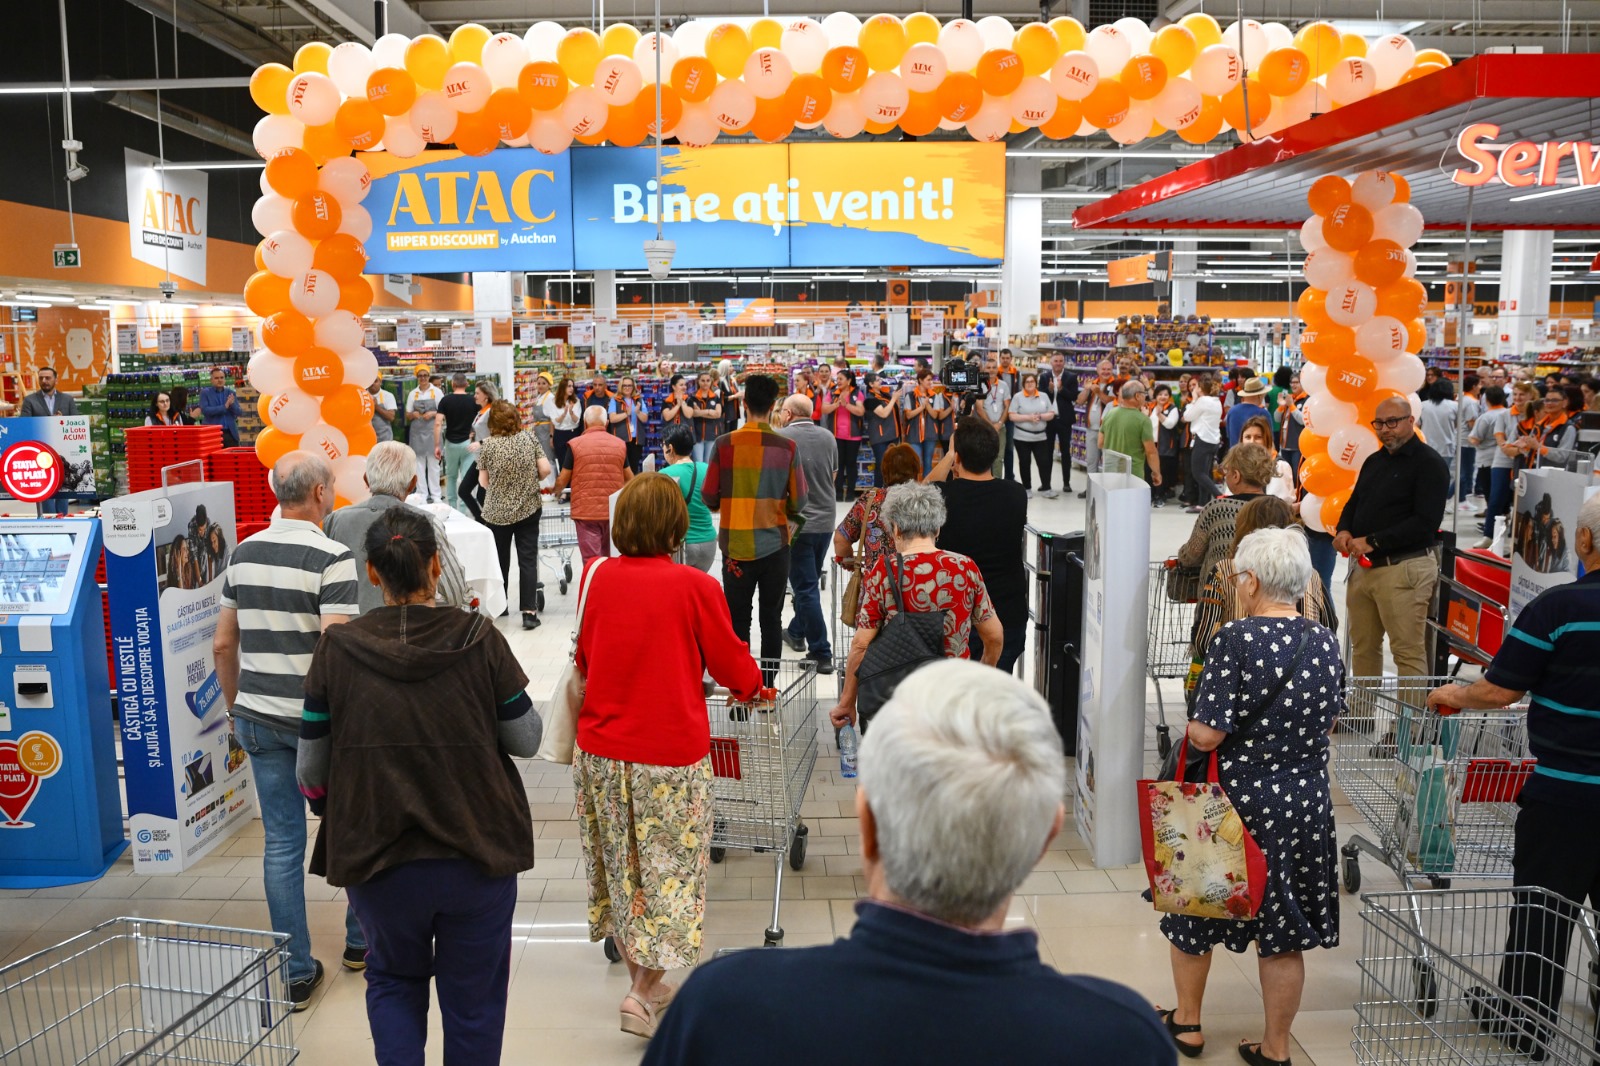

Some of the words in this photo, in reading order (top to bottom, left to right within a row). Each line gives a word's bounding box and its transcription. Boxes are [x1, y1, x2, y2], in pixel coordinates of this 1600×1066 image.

[763, 53, 772, 75] ATAC
[911, 62, 934, 72] ATAC
[532, 77, 558, 87] ATAC
[604, 68, 620, 91] ATAC
[1068, 66, 1092, 82] ATAC
[446, 81, 469, 94] ATAC
[877, 108, 899, 117] ATAC
[1023, 110, 1048, 119] ATAC
[386, 169, 556, 226] ATAC
[142, 187, 202, 236] ATAC
[612, 179, 720, 224] Bine
[733, 177, 800, 236] ați
[813, 176, 955, 221] venit!
[187, 241, 203, 250] Auchan
[390, 235, 428, 247] HIPER
[430, 233, 496, 247] DISCOUNT
[501, 237, 509, 246] by
[510, 232, 556, 244] Auchan
[1342, 288, 1356, 312] ATAC
[302, 366, 329, 377] ATAC
[1338, 373, 1364, 388] ATAC
[272, 397, 289, 417] ATAC
[320, 440, 338, 460] ATAC
[1341, 442, 1357, 463] ATAC
[12, 472, 22, 480] DE
[23, 469, 47, 480] PLATĂ
[113, 523, 137, 531] Nestlé
[135, 607, 152, 646] VOCAȚIA
[114, 636, 135, 675] NESTLÉ
[138, 646, 155, 695] DESCOPERE
[186, 657, 205, 675] MARELE
[122, 677, 138, 692] CU
[187, 671, 206, 687] PREMIU
[142, 696, 158, 722] SĂ-ȘI
[122, 694, 143, 741] CÂȘTIGĂ
[144, 722, 160, 758] AJUTĂ-I
[4, 772, 26, 783] PLATĂ
[228, 799, 245, 814] Auchan
[1204, 802, 1226, 814] CACAO
[154, 854, 169, 862] YOU
